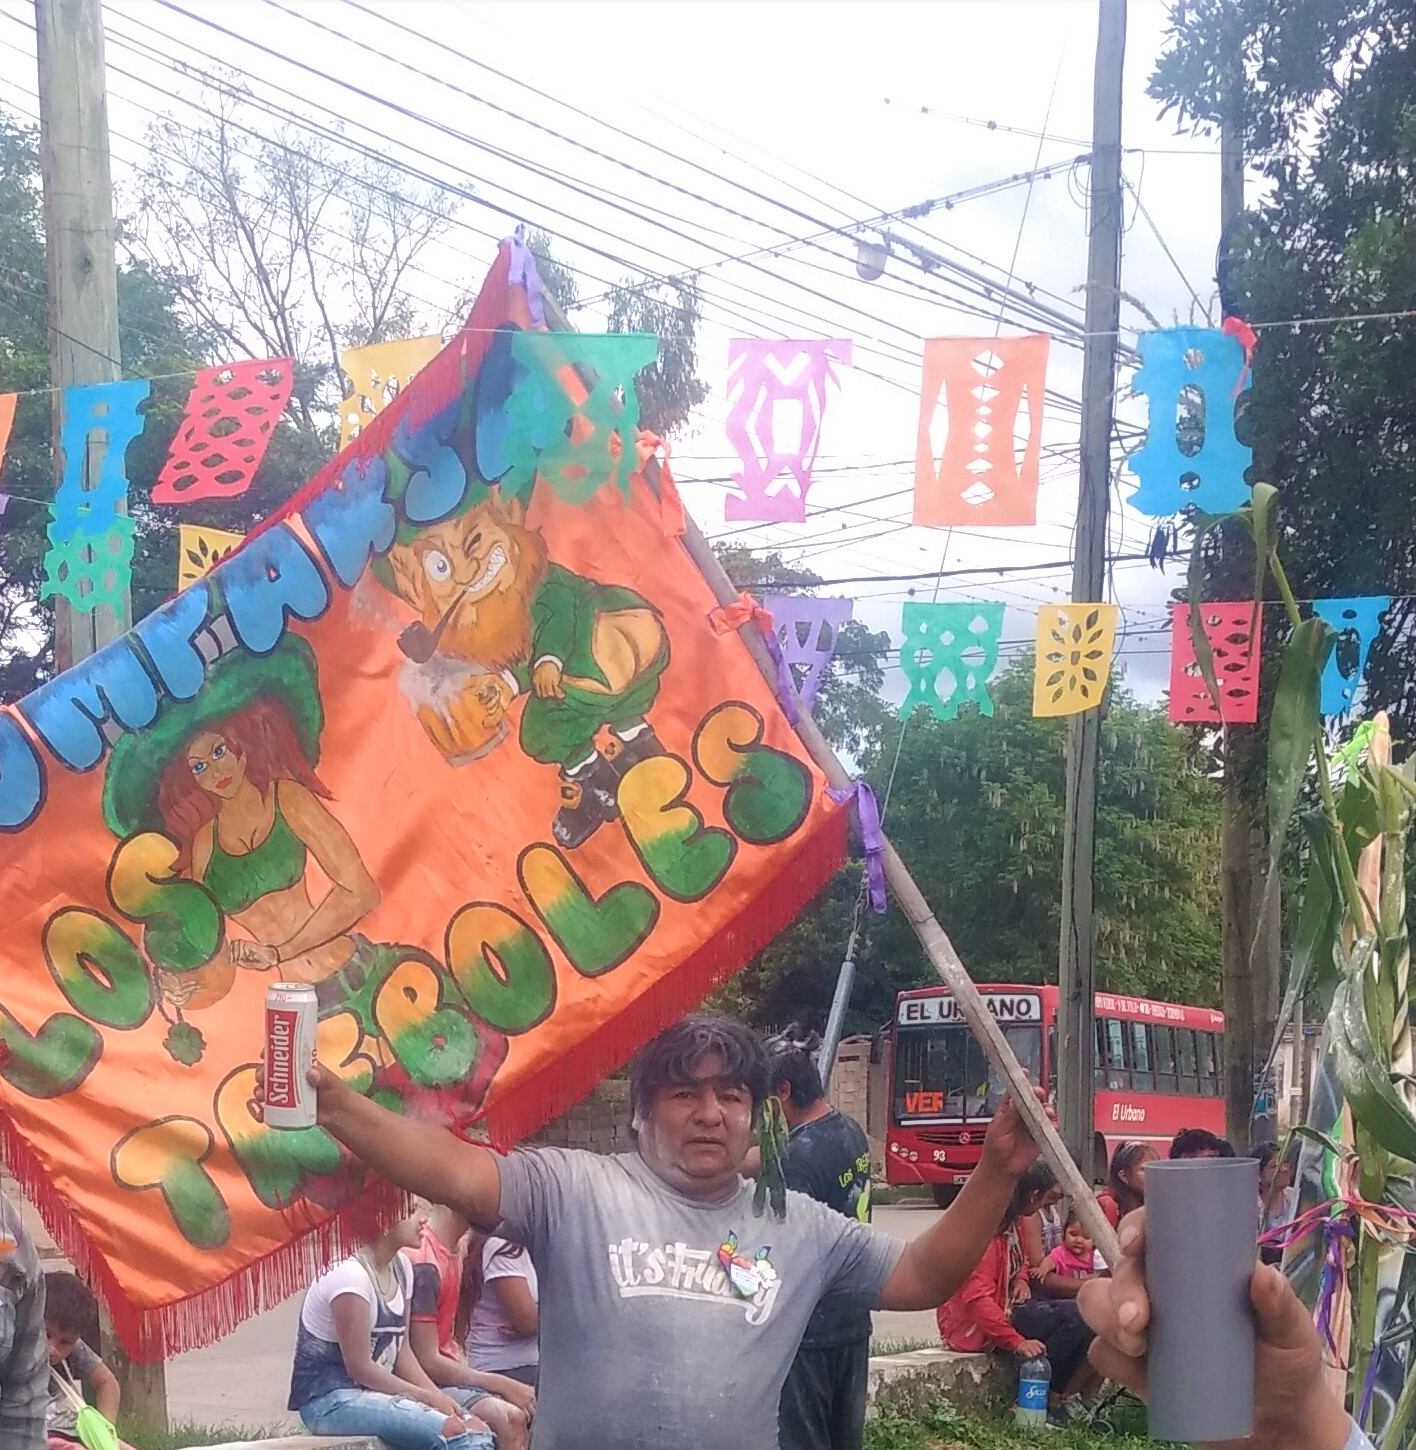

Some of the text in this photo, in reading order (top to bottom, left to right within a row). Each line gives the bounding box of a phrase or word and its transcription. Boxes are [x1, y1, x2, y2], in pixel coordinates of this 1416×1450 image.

[906, 998, 1032, 1020] EL URANO
[268, 1014, 290, 1104] Schneider
[1112, 1104, 1145, 1121] El Urbano
[933, 1150, 946, 1162] 93
[609, 1237, 665, 1287] it's
